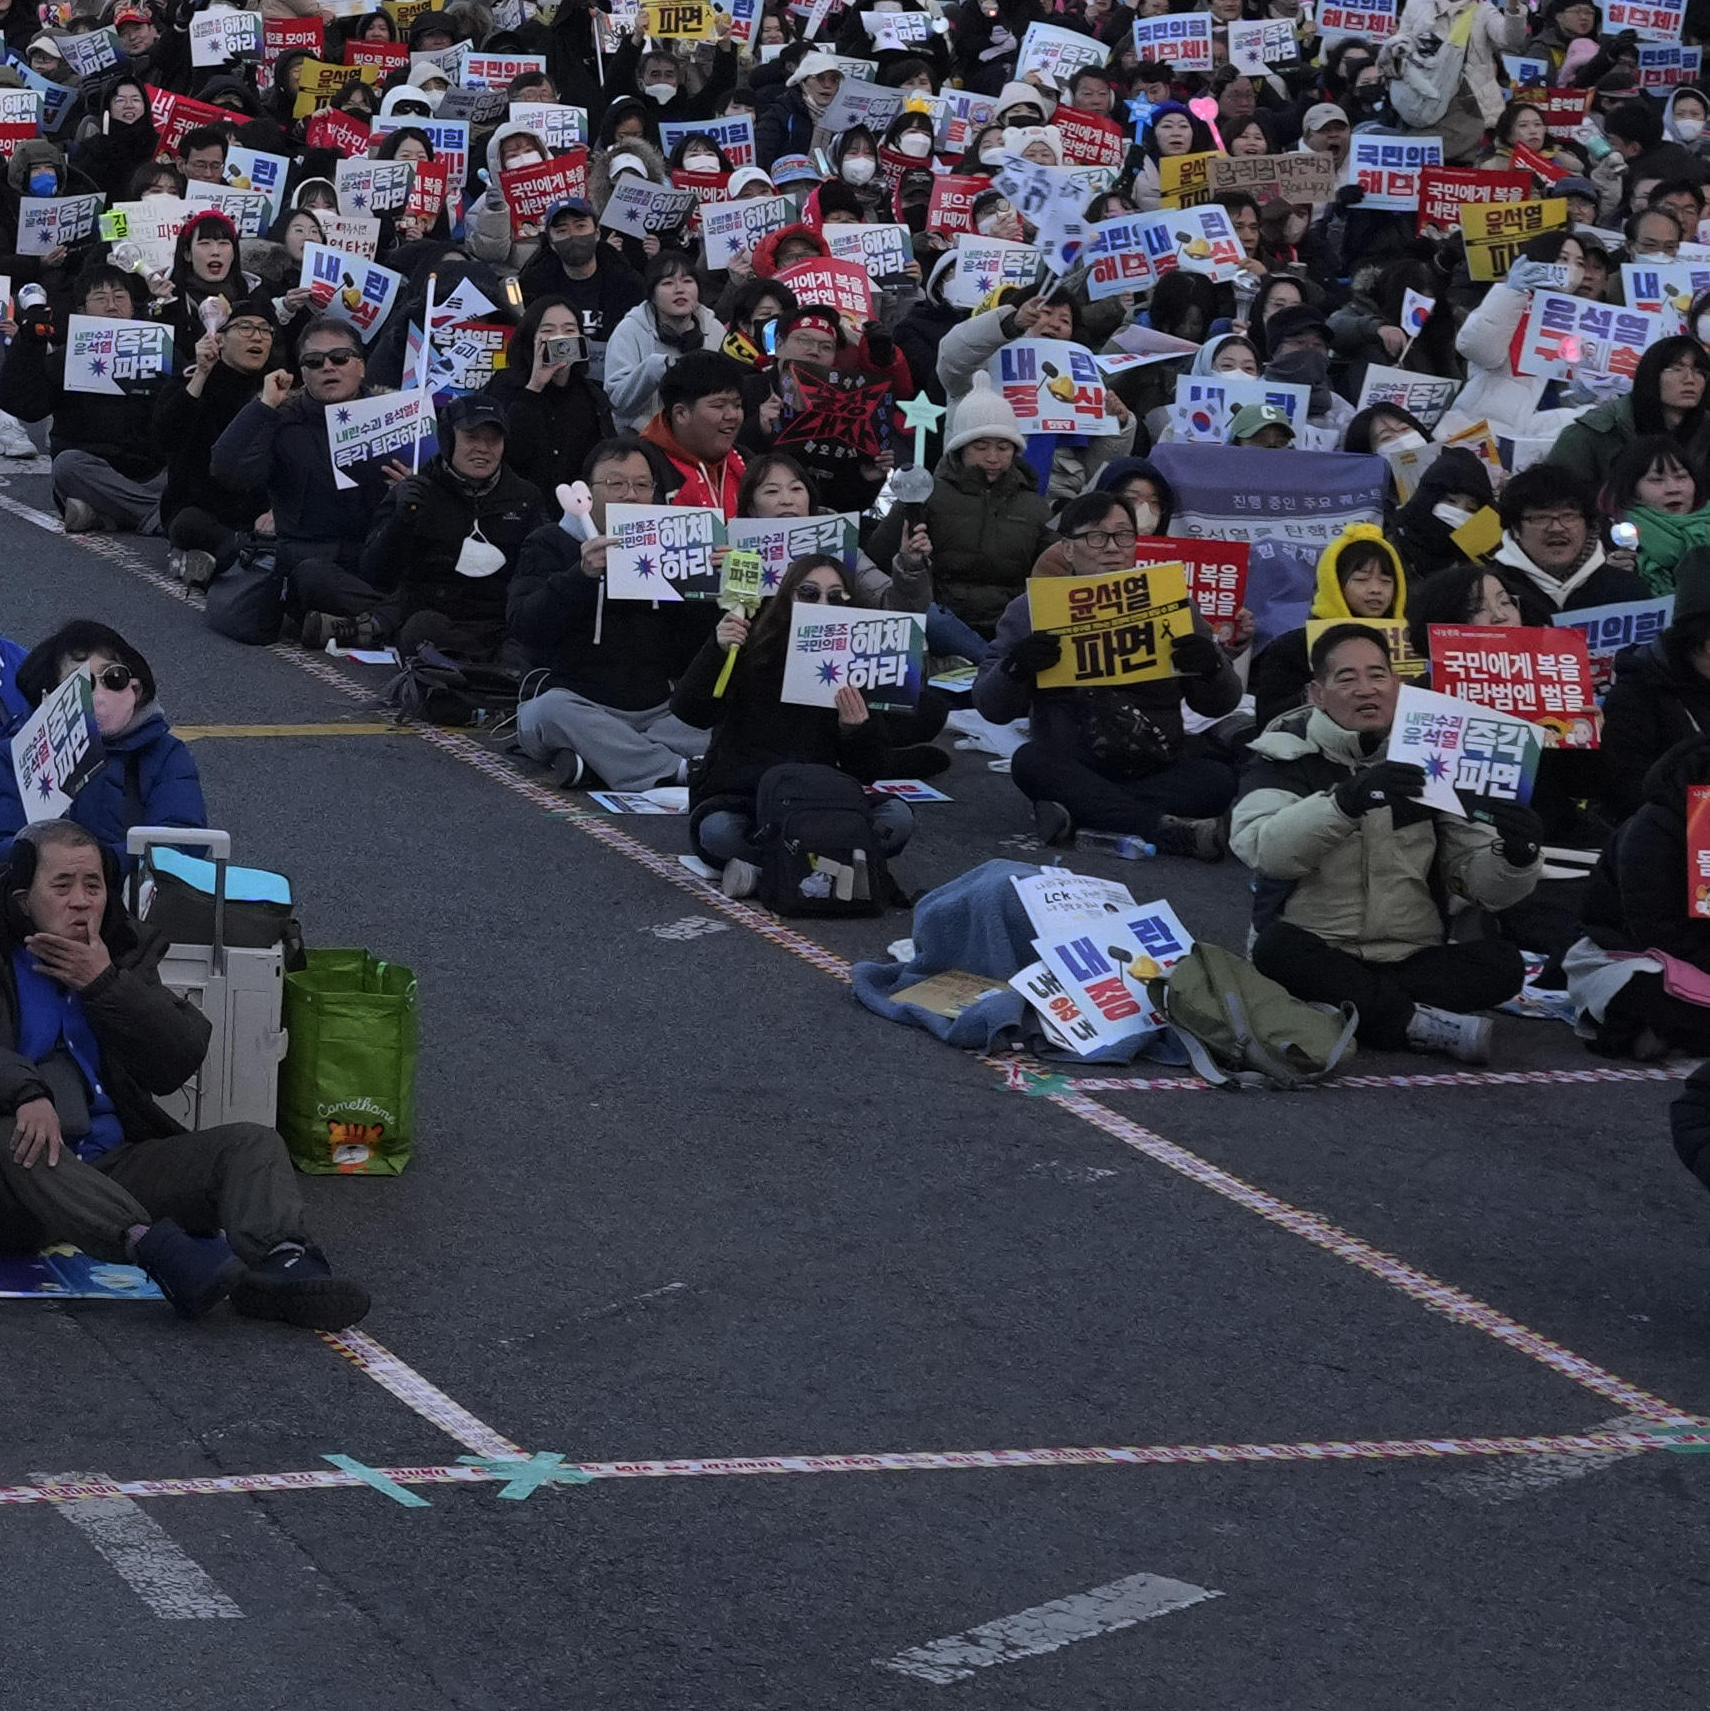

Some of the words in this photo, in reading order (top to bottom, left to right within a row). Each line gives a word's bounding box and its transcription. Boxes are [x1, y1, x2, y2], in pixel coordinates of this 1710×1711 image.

[659, 7, 702, 32] 파면
[1484, 202, 1542, 236] 윤석열
[1541, 298, 1650, 344] 윤석열
[115, 321, 166, 357] 즉각
[113, 351, 164, 382] 파면
[335, 440, 367, 469] 즉각
[660, 513, 716, 548] 해체
[659, 545, 712, 580] 하라
[1193, 563, 1239, 588] 복을
[1067, 575, 1152, 616] 윤석열
[1196, 589, 1237, 615] 벌을
[796, 636, 849, 653] 국민의힘
[797, 623, 849, 641] 내란동조
[851, 618, 911, 658] 해체
[847, 653, 909, 689] 하라
[1076, 633, 1158, 680] 파면
[1443, 651, 1530, 682] 국민에게
[1536, 653, 1580, 683] 복을
